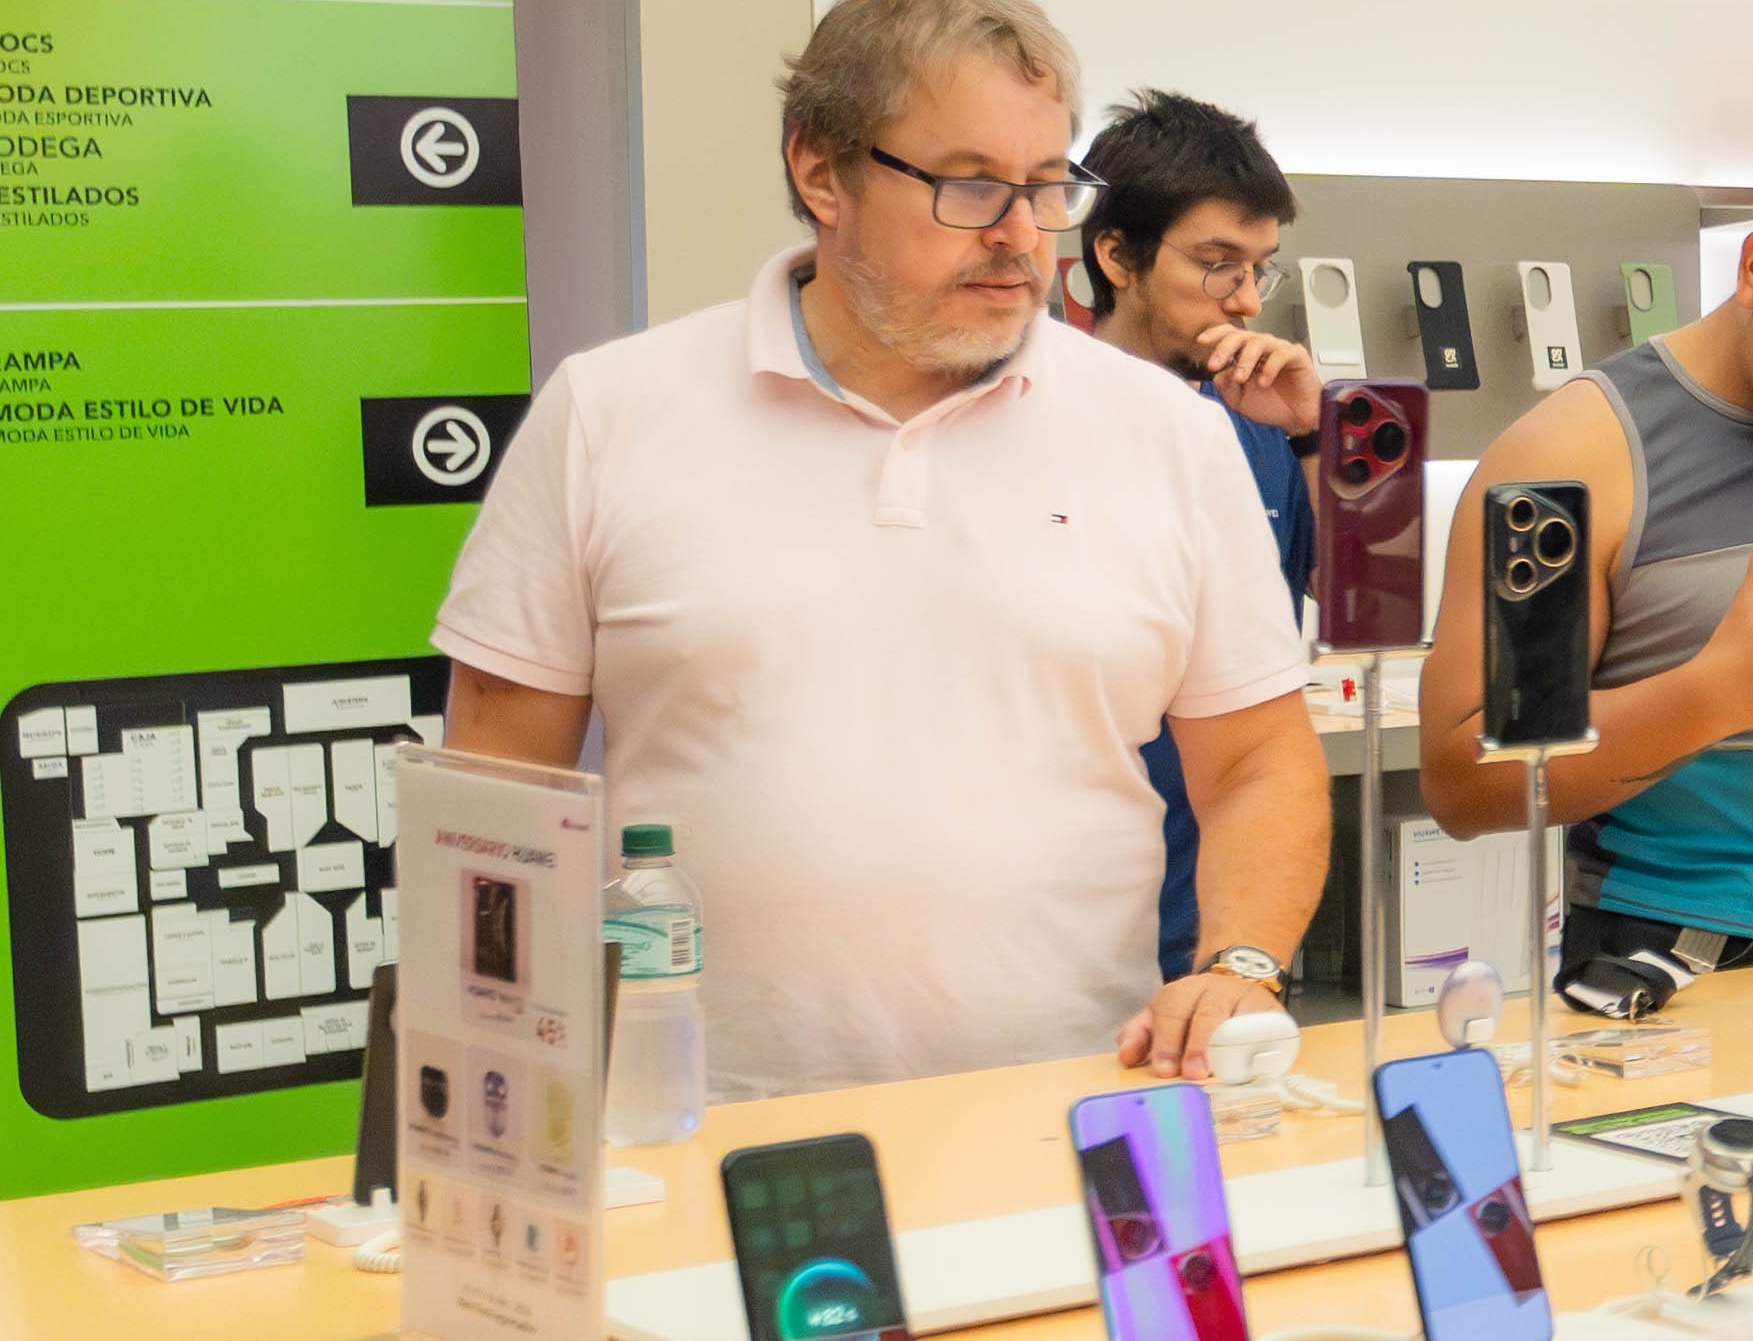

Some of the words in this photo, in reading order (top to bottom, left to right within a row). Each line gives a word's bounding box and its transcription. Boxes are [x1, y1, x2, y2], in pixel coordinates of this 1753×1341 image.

[65, 86, 213, 109] DEPORTIVA
[0, 111, 30, 126] DA
[35, 112, 134, 127] ESPORTIVA
[0, 351, 81, 372] AMPA
[83, 399, 172, 420] ESTILO
[180, 397, 214, 417] DE
[222, 395, 285, 416] VIDA
[53, 427, 114, 442] ESTILO
[120, 425, 142, 440] DE
[147, 423, 191, 439] VIDA
